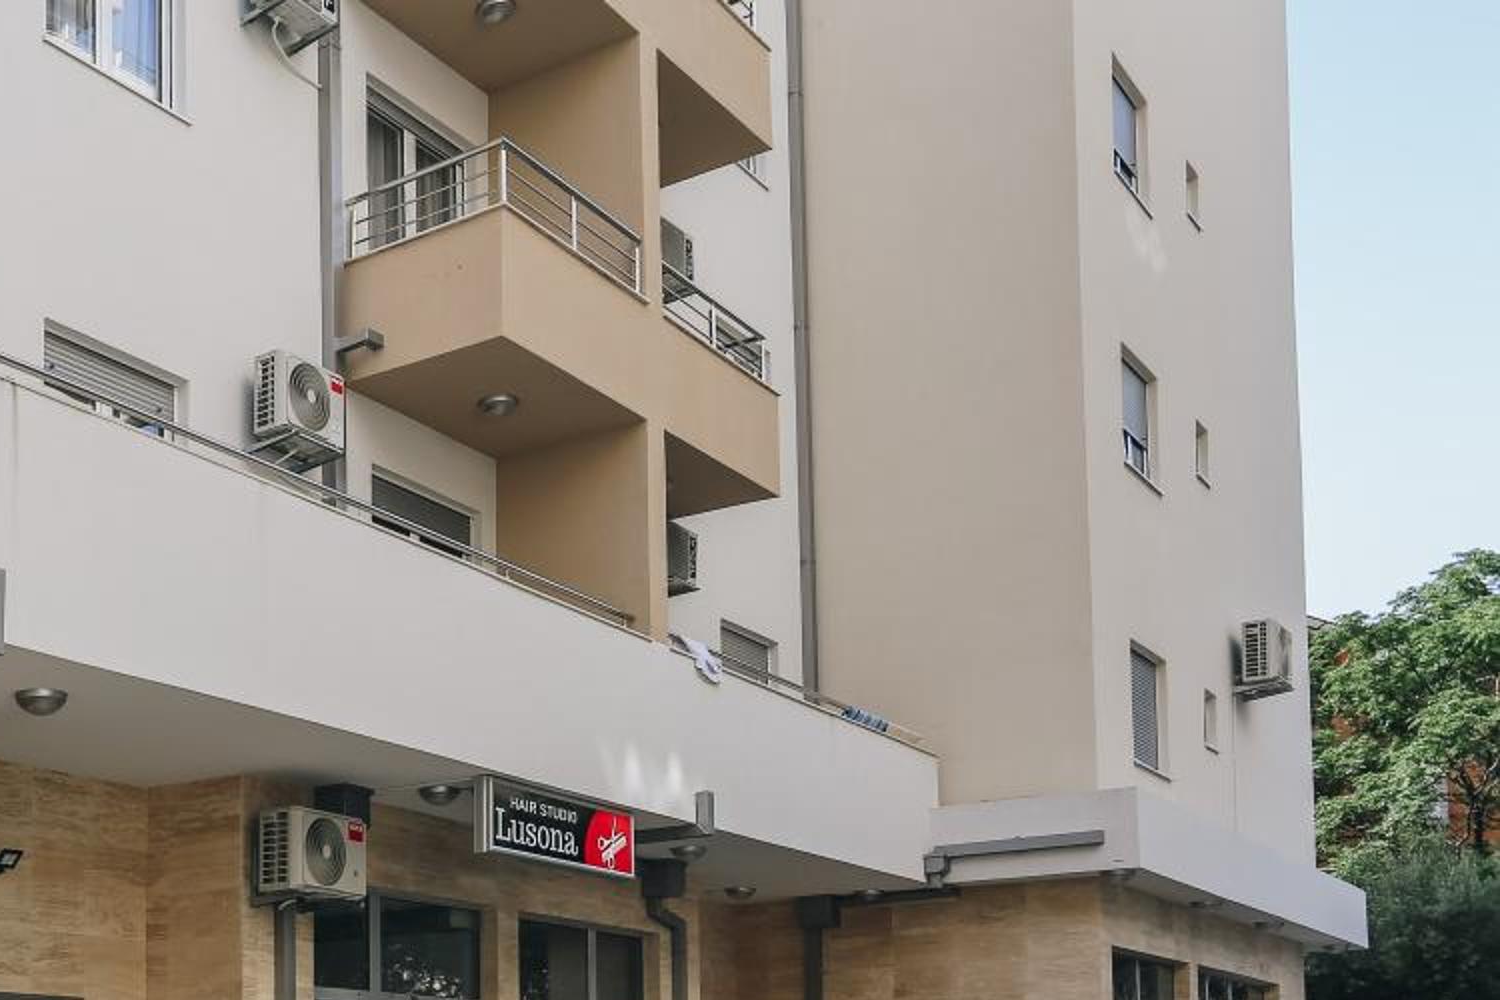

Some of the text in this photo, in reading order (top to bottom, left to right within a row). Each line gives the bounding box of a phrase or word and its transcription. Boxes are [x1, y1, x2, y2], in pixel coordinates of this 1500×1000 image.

[510, 797, 578, 824] HAIR STUDIO
[495, 806, 579, 856] Lusona
